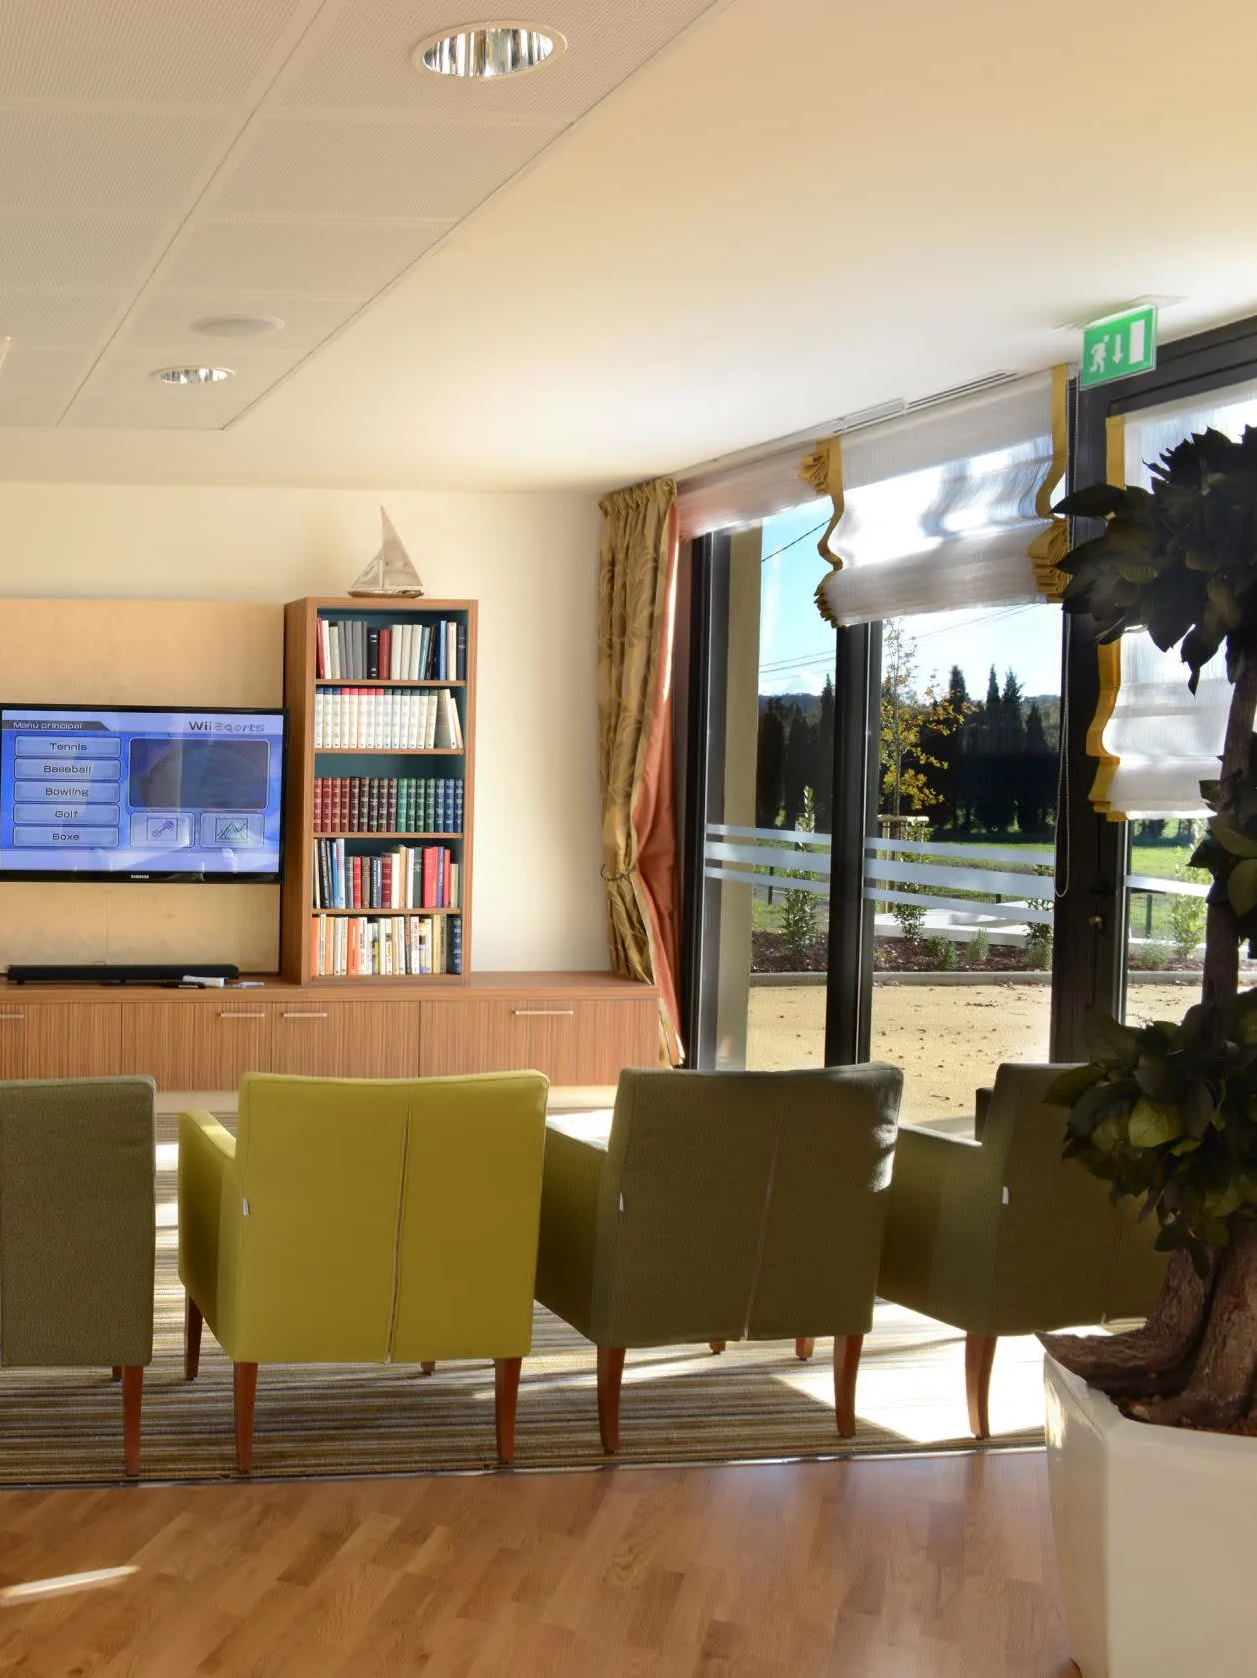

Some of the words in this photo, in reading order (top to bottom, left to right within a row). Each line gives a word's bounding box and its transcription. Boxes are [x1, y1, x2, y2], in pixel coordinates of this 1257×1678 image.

[13, 720, 39, 730] Menu
[41, 720, 82, 731] principal
[189, 720, 212, 732] Wii
[49, 742, 87, 752] Tennis
[43, 764, 91, 774] Baseball
[45, 787, 89, 797] Bowling
[54, 809, 78, 819] Golf
[52, 832, 80, 842] Boxe
